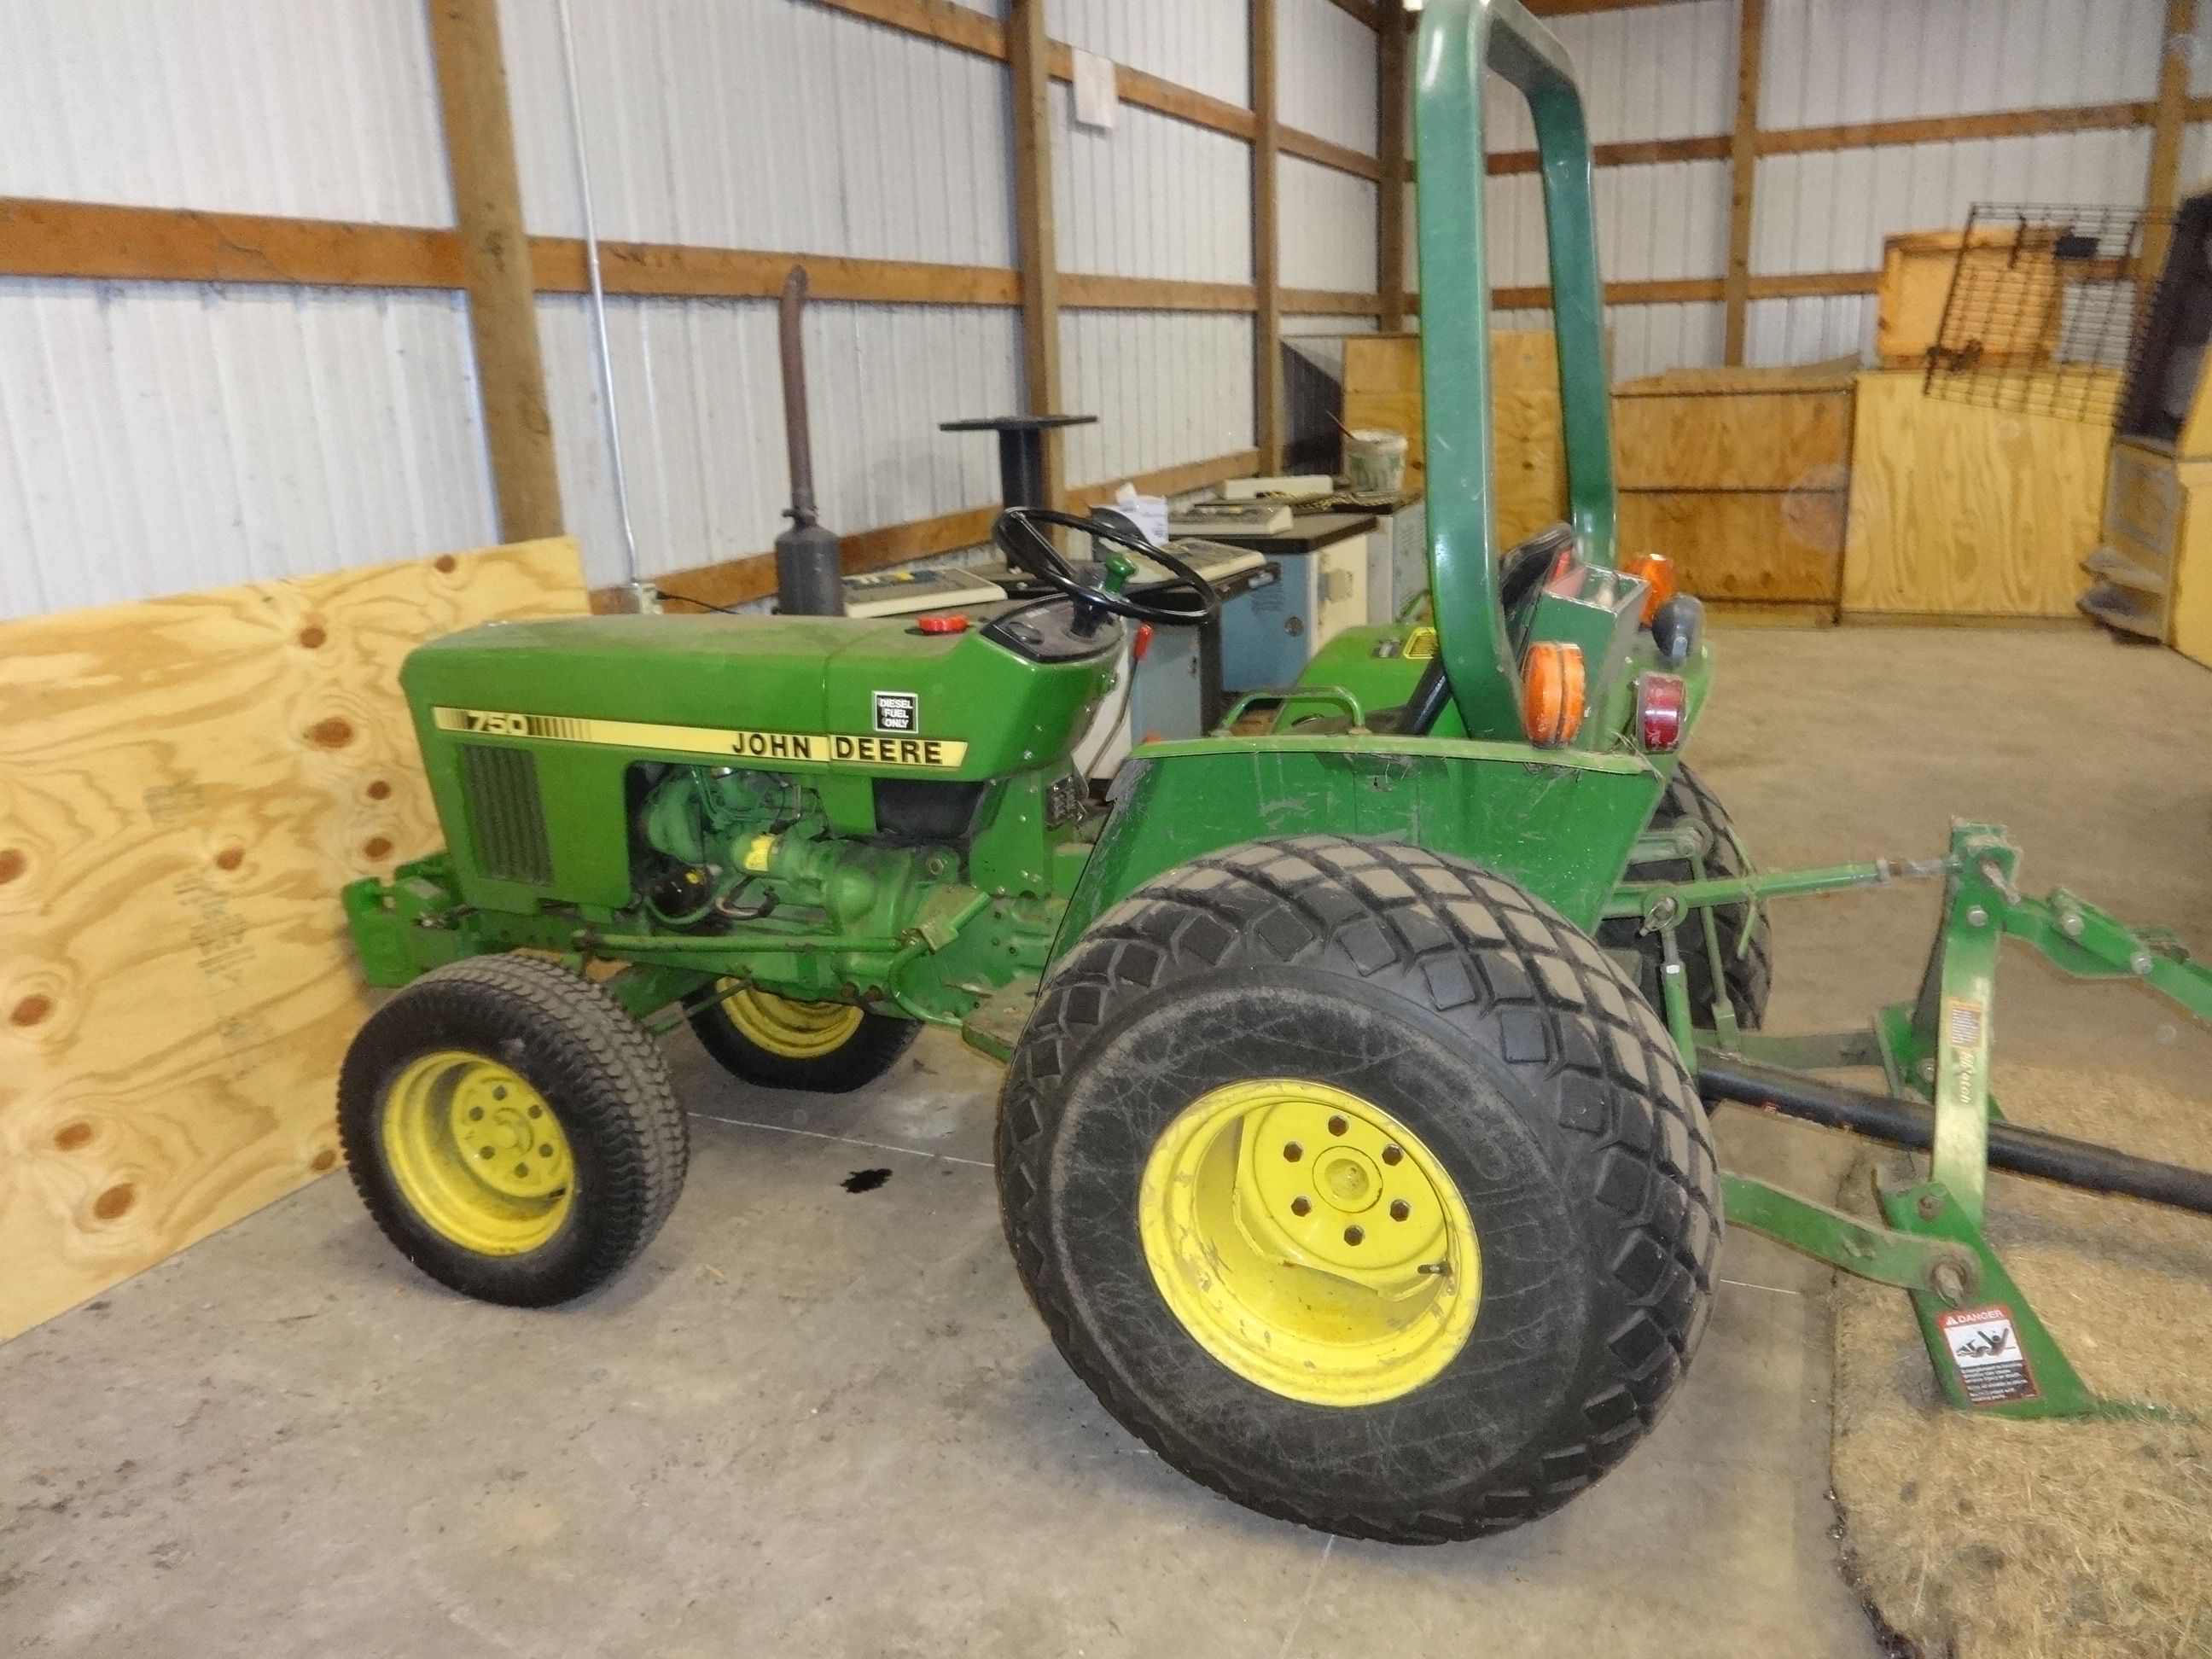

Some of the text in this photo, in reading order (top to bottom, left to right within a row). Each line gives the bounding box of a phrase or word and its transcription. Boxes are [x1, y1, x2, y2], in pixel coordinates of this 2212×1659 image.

[878, 698, 913, 709] DIESEL
[882, 708, 909, 719] FUEL
[469, 712, 529, 736] 750
[883, 718, 909, 729] ONLY
[732, 732, 943, 765] JOHN DEERE
[1957, 1309, 2005, 1324] DANGER
